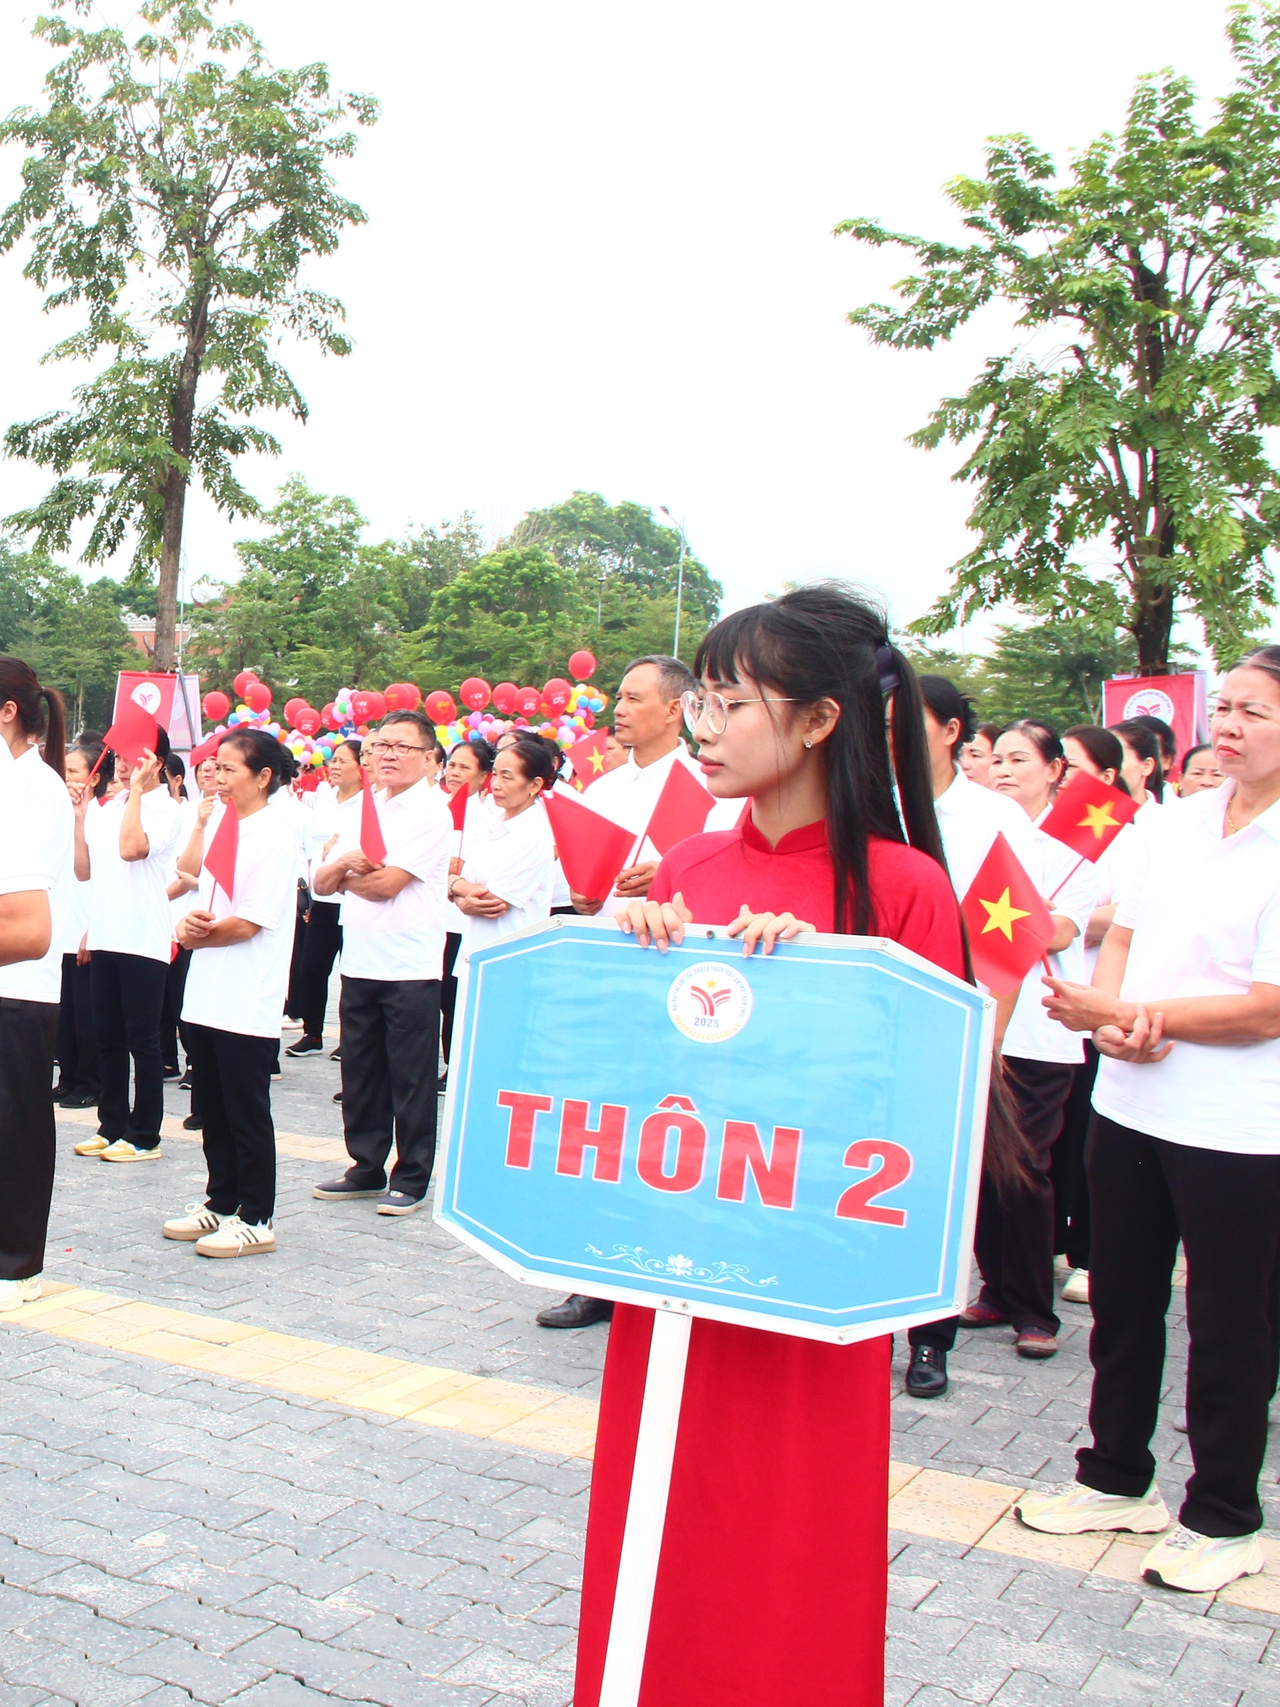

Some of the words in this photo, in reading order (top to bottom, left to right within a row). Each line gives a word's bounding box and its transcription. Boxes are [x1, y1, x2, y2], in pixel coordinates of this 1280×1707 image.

[694, 1017, 719, 1028] 2025
[496, 1089, 803, 1212] THÔN
[834, 1137, 914, 1229] 2
